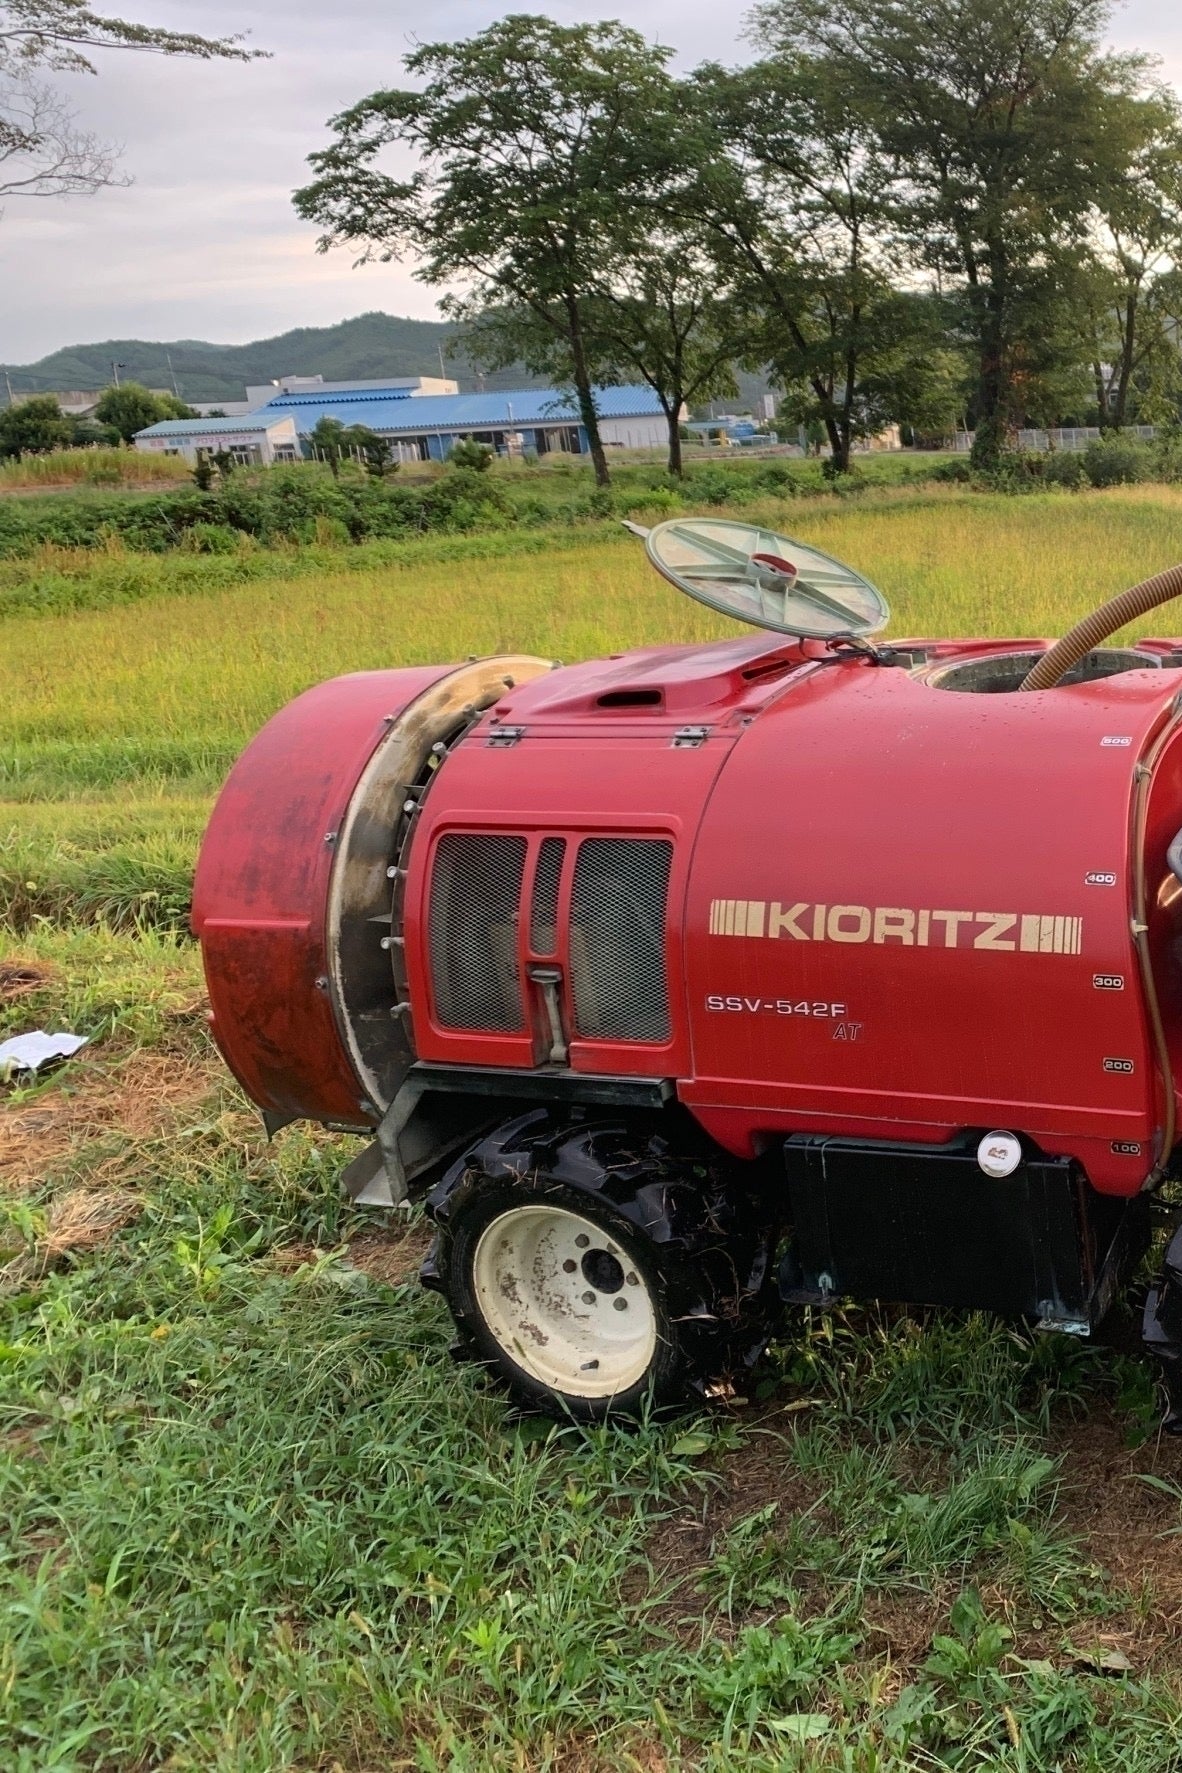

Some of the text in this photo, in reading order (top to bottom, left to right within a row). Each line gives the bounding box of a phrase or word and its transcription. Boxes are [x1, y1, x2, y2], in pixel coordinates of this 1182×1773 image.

[1102, 737, 1130, 745] 500
[1087, 873, 1115, 883] 400
[768, 901, 1018, 951] KIORITZ
[1095, 977, 1122, 987] 300
[707, 996, 845, 1017] SSV-542F
[832, 1022, 862, 1041] AT
[1105, 1060, 1132, 1071] 200
[1113, 1144, 1139, 1153] 100
